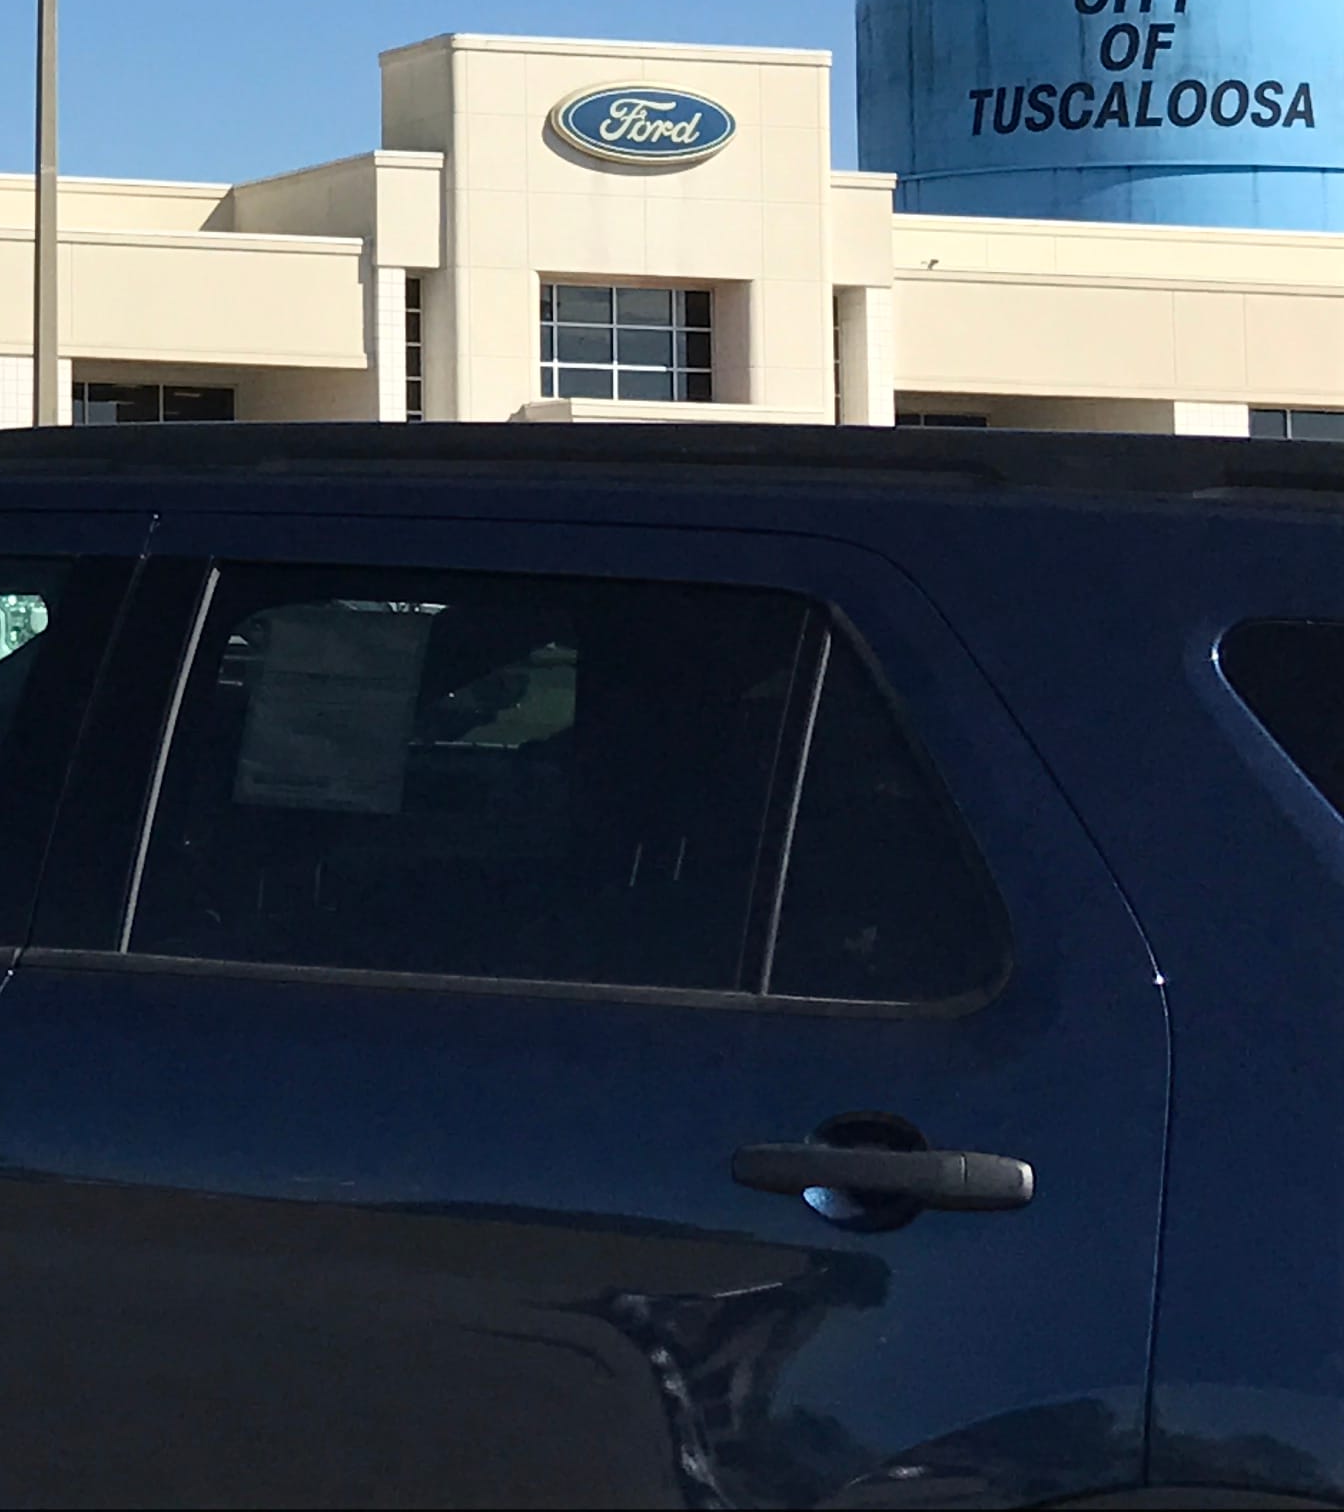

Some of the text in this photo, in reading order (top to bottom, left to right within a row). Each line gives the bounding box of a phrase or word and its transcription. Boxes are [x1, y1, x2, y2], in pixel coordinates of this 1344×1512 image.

[1099, 22, 1175, 72] OF
[599, 97, 703, 144] Ford
[968, 79, 1316, 137] TUSCALOOSA
